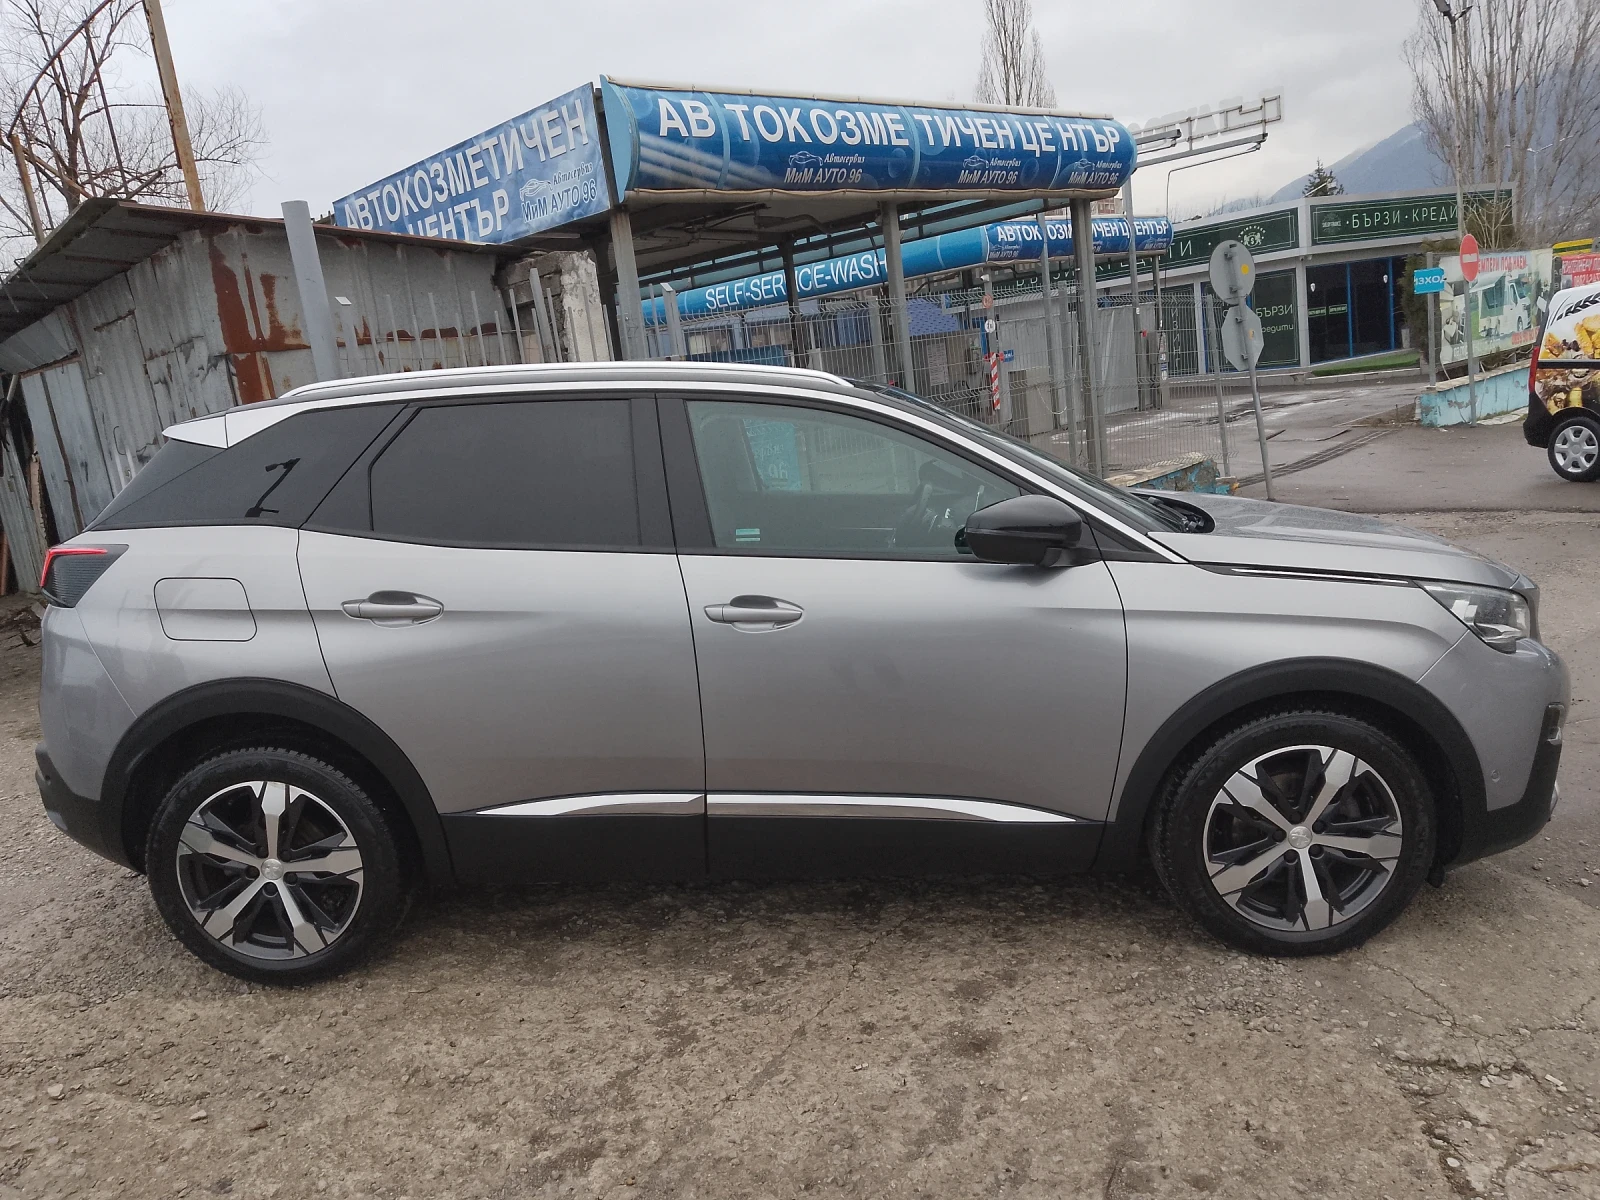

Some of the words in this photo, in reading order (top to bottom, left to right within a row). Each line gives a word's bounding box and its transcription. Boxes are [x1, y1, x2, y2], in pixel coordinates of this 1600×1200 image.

[344, 98, 589, 230] АВТОКОЗМЕТИЧЕН
[814, 167, 847, 183] АУТО
[848, 167, 862, 184] 96
[980, 169, 1003, 184] АУТО
[1004, 169, 1018, 184] 96
[1087, 171, 1108, 184] АУТО
[1108, 171, 1118, 184] 96
[551, 184, 580, 214] АУТО
[582, 179, 597, 203] 96
[1352, 210, 1401, 228] БЪРЗИ
[705, 254, 888, 309] SELF-SERICE-WASH
[1255, 304, 1293, 318] БЪРЗИ
[1261, 324, 1294, 334] редити
